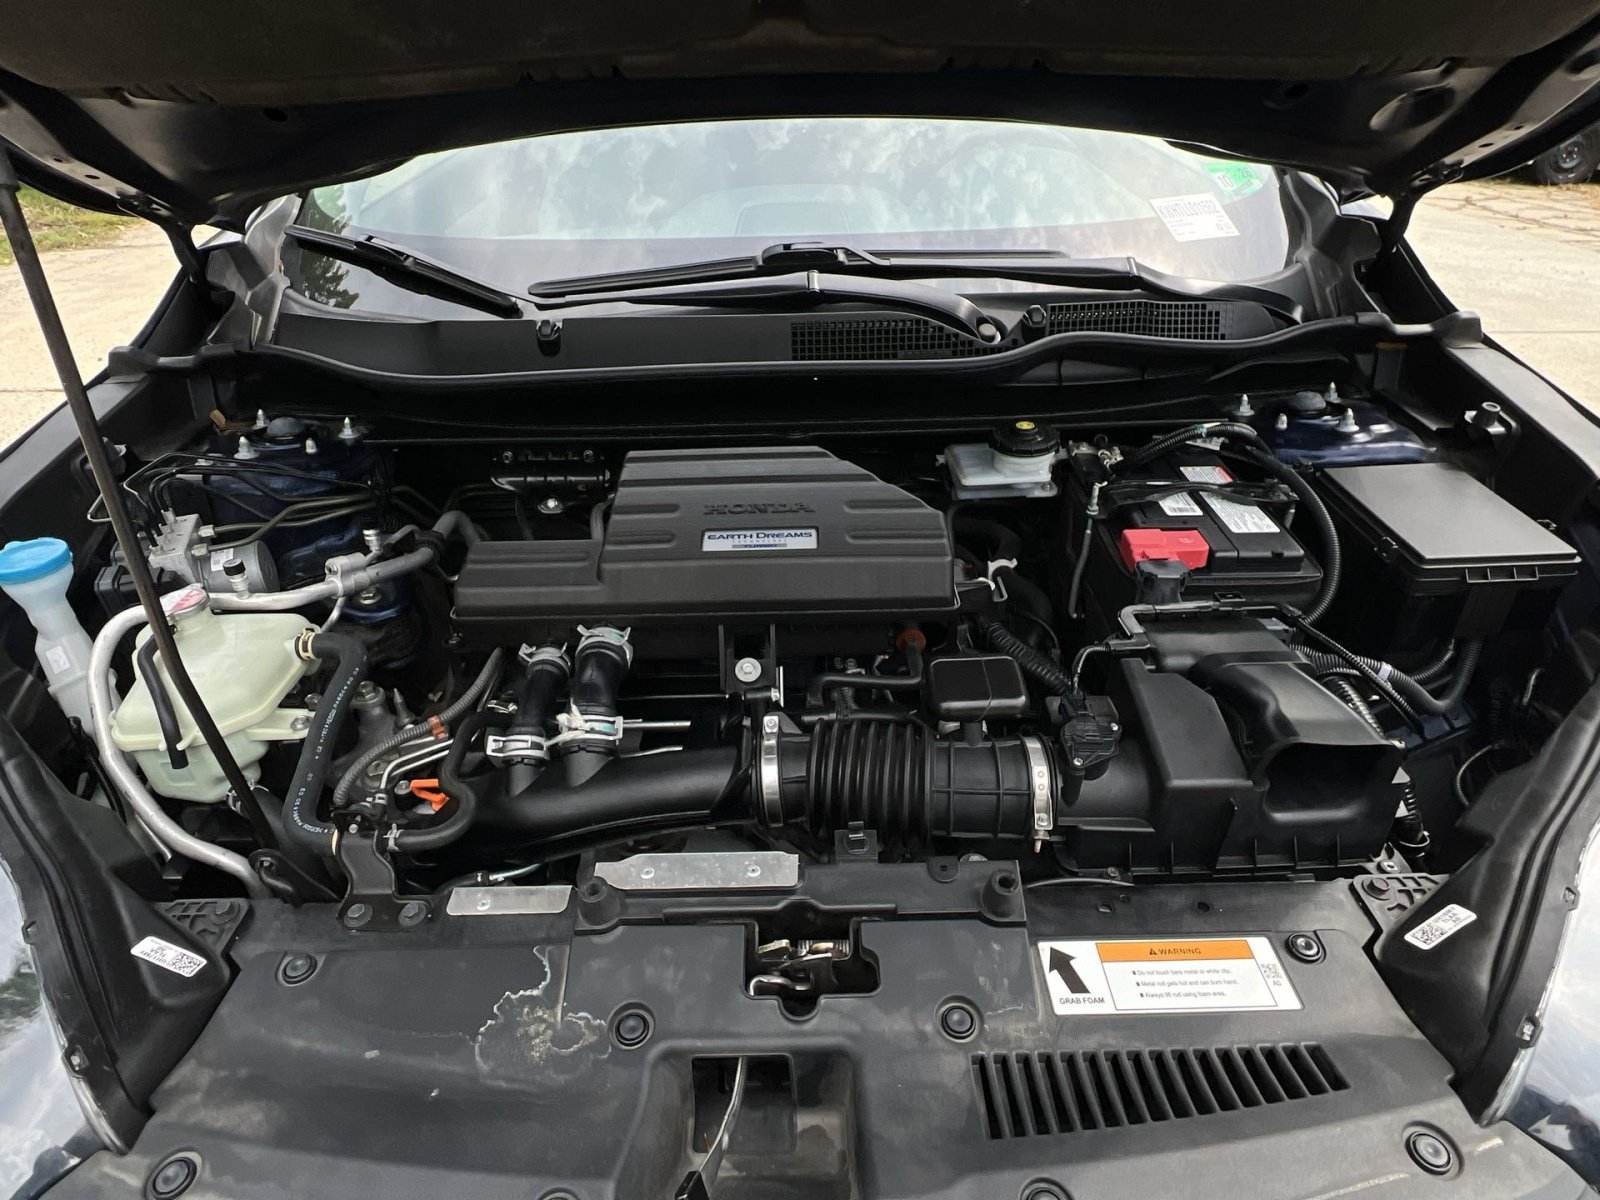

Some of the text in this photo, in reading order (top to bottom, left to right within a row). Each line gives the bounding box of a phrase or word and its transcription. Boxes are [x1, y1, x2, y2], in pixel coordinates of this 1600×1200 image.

[703, 502, 816, 516] HONDA
[756, 531, 813, 539] DREAMS
[1158, 947, 1202, 956] WARNING
[1059, 996, 1106, 1005] GRAB FOAM
